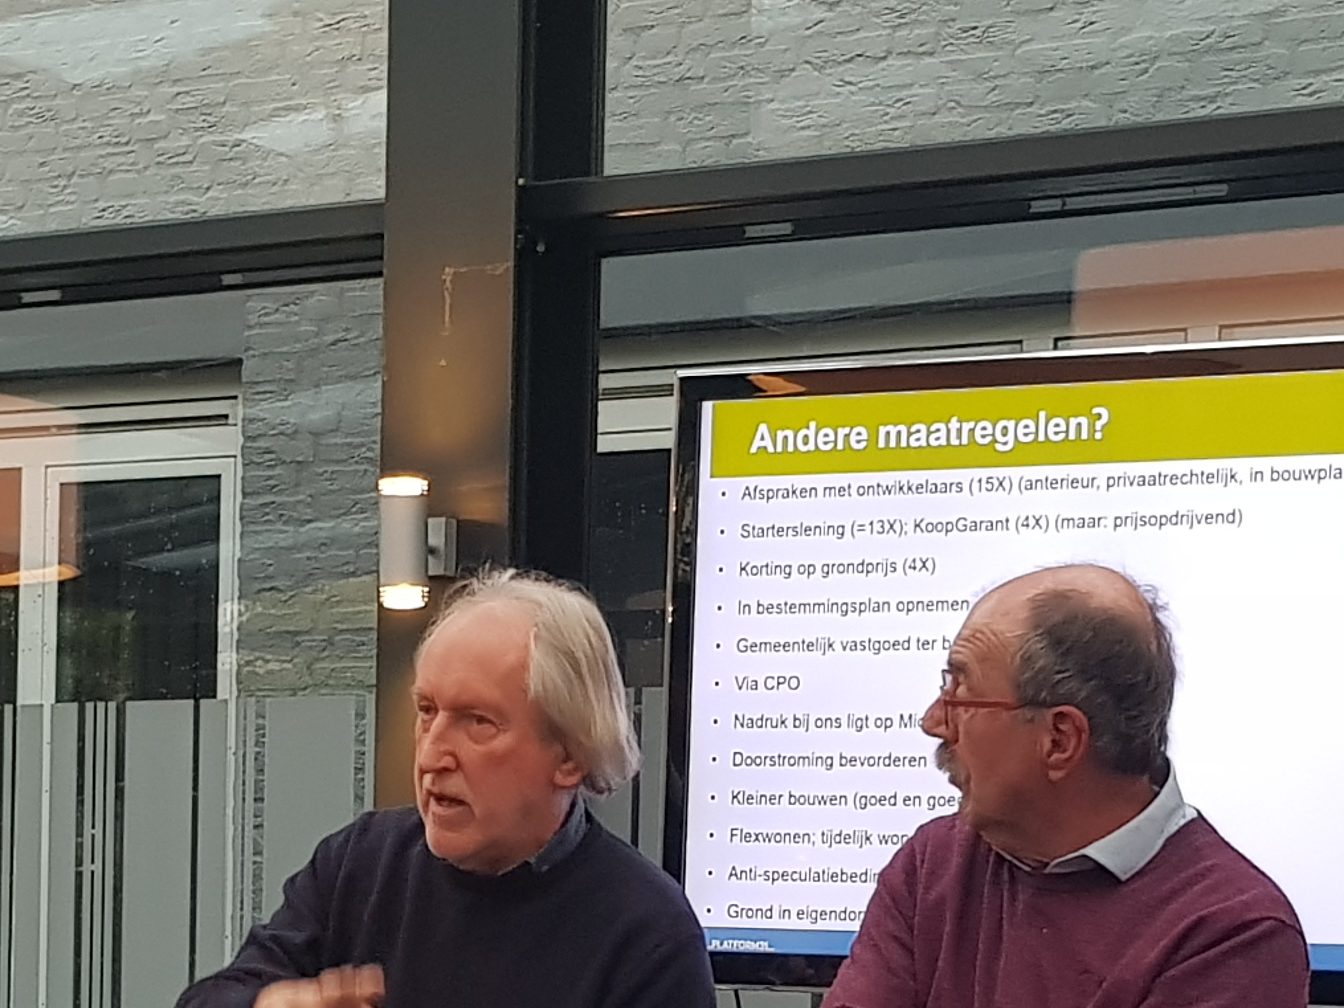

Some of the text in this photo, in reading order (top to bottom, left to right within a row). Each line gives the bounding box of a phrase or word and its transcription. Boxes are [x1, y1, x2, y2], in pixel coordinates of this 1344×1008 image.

[749, 407, 1110, 453] Andere maatregelen?
[740, 483, 818, 504] Afspraken
[823, 482, 852, 498] met
[856, 478, 964, 497] ontwikkelaars
[968, 476, 1013, 497] (15X)
[1018, 475, 1100, 494] (anterieur,
[1106, 469, 1244, 492] privaatrechtelijk,
[1249, 467, 1265, 483] in
[740, 508, 1243, 540] Starterslening (=13X); KoopGarant (4X) (maar: prijsopdrijvend)
[739, 557, 936, 580] Korting op grondprijs (4X)
[738, 597, 969, 618] In bestemmingsplan opnemen
[736, 637, 836, 656] Gemeentelijk
[840, 635, 911, 656] vastgoed
[916, 636, 938, 651] ter
[734, 675, 801, 691] Via CPO
[733, 713, 922, 733] Nadruk bij ons ligt op Mi
[732, 751, 927, 771] Doorstroming bevorderen
[730, 789, 963, 811] Kleiner bouwen (goed en goe
[729, 827, 816, 847] Flexwonen;
[820, 829, 873, 849] tijdelijk
[728, 865, 880, 885] Anti-speculatiebedi
[726, 903, 865, 925] Grond in eigendo
